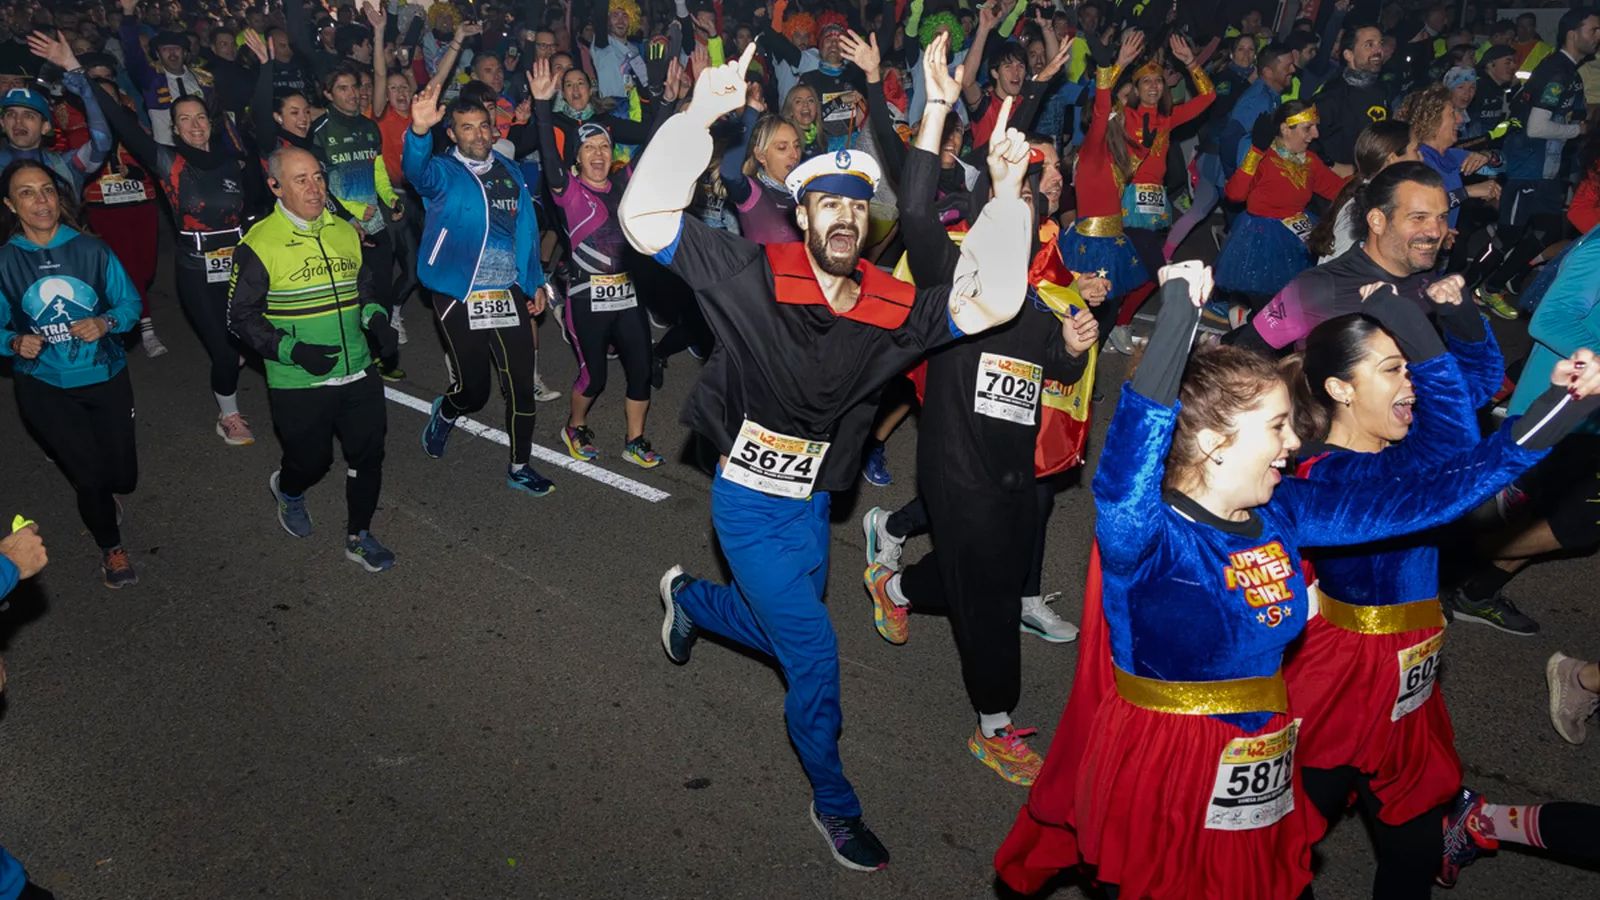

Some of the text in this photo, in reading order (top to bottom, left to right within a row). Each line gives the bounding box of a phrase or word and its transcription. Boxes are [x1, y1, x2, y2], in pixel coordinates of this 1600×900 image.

[331, 152, 351, 164] SAN
[105, 180, 140, 193] 7960
[211, 257, 232, 270] 95
[595, 281, 631, 299] 9017
[473, 299, 511, 315] 5581
[985, 371, 1036, 401] 7029
[740, 440, 814, 476] 5674
[1228, 541, 1289, 571] UPER
[1243, 581, 1295, 609] GIRL
[1267, 605, 1282, 628] S
